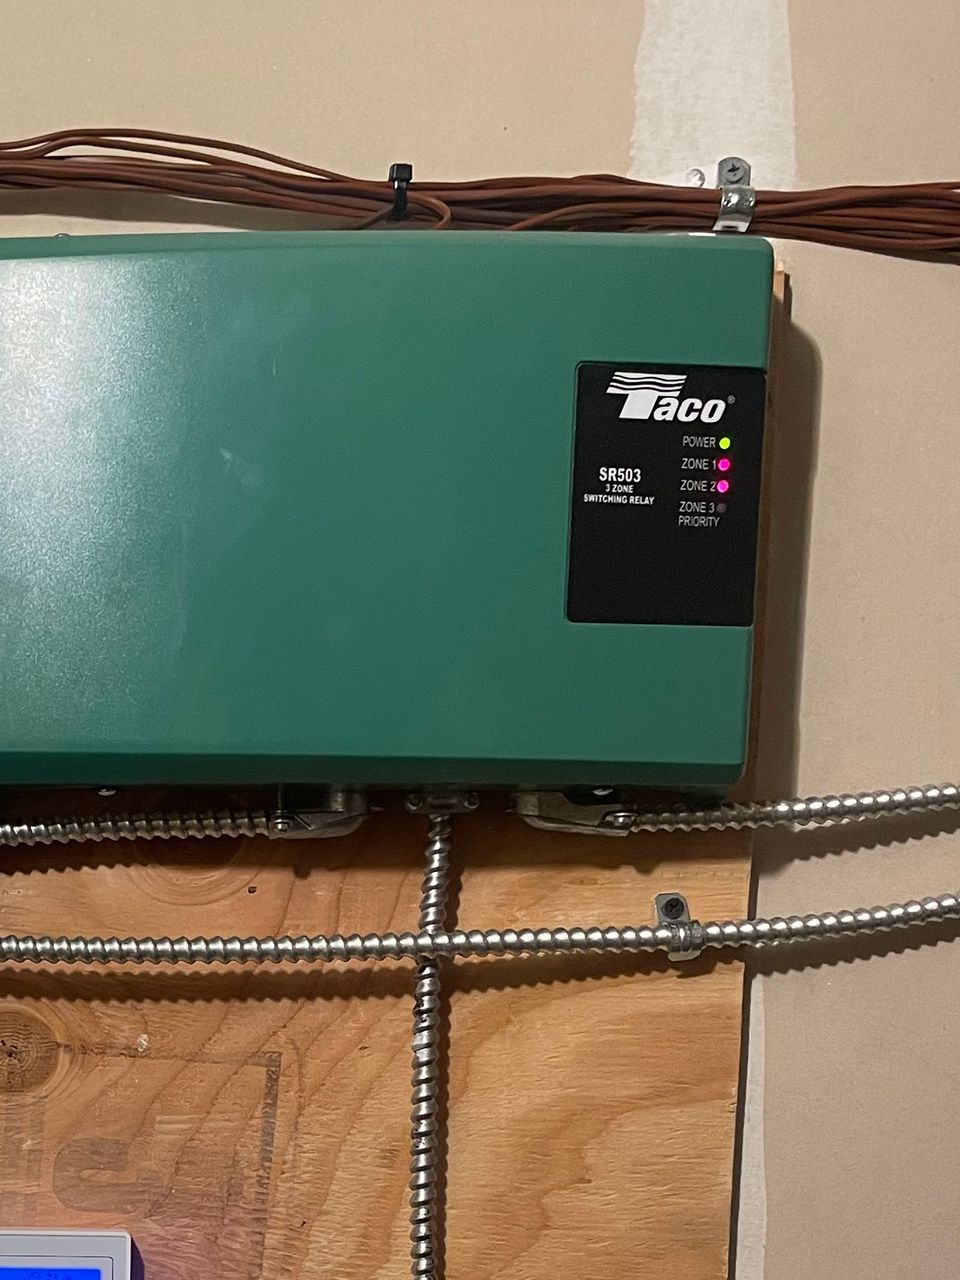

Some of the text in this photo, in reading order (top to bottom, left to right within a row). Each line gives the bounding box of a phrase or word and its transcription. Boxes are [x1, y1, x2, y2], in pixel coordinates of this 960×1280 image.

[606, 371, 726, 424] Taco
[682, 436, 716, 448] POWER
[681, 458, 717, 471] ZONE 1
[598, 467, 642, 483] SR503
[605, 484, 634, 494] 3 ZONE
[679, 480, 717, 492] ZONE 2
[583, 493, 655, 506] SWITCHING RELAY
[679, 501, 715, 513] ZONE 3
[678, 516, 720, 528] PRIORITY
